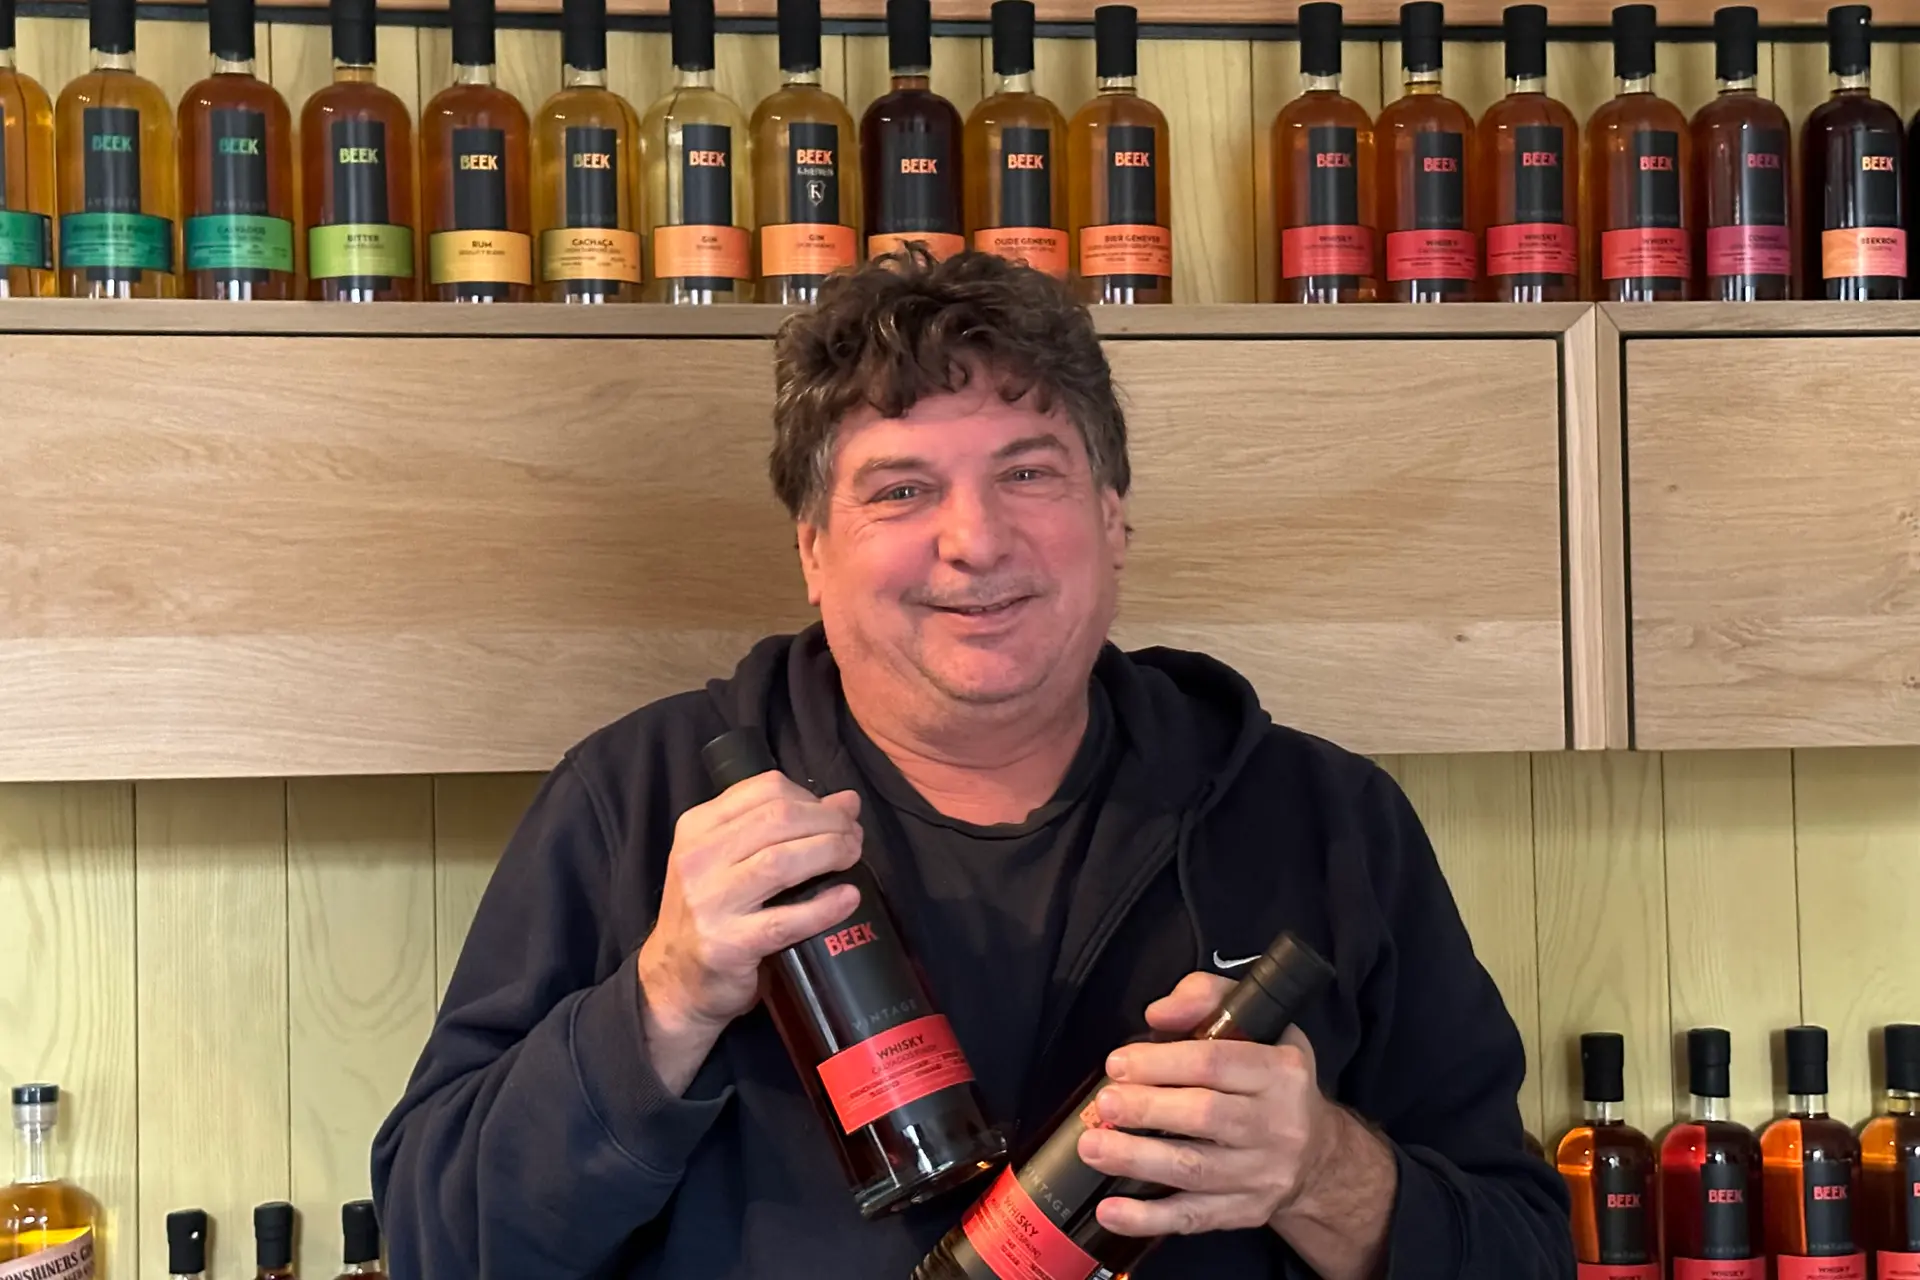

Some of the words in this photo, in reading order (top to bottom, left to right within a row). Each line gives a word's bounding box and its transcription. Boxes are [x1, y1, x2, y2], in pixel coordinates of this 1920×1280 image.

[339, 147, 378, 165] BEEK
[460, 154, 499, 171] BEEK
[572, 153, 611, 169] BEEK
[689, 150, 726, 167] BEEK
[796, 149, 833, 166] BEEK
[1007, 153, 1044, 170] BEEK
[1114, 151, 1151, 168] BEEK
[1316, 153, 1352, 168] BEEK
[1522, 152, 1558, 167] BEEK
[1639, 156, 1673, 172] BEEK
[1746, 153, 1780, 169] BEEK
[1862, 156, 1895, 172] BEEK
[900, 158, 938, 175] BEEK
[1423, 157, 1457, 173] BEEK
[471, 239, 493, 248] RUM
[571, 238, 615, 249] CACHAÇA
[994, 238, 1020, 246] OUDE
[823, 921, 879, 957] BEEK
[850, 998, 918, 1031] VINTAGE
[876, 1034, 926, 1059] WHISKY
[1025, 1163, 1073, 1221] VINTAGE
[1707, 1188, 1744, 1204] BEEK
[1813, 1185, 1849, 1201] BEEK
[1606, 1193, 1642, 1209] BEEK
[1003, 1196, 1040, 1238] WHISKY
[0, 1251, 79, 1280] ONSHINERS
